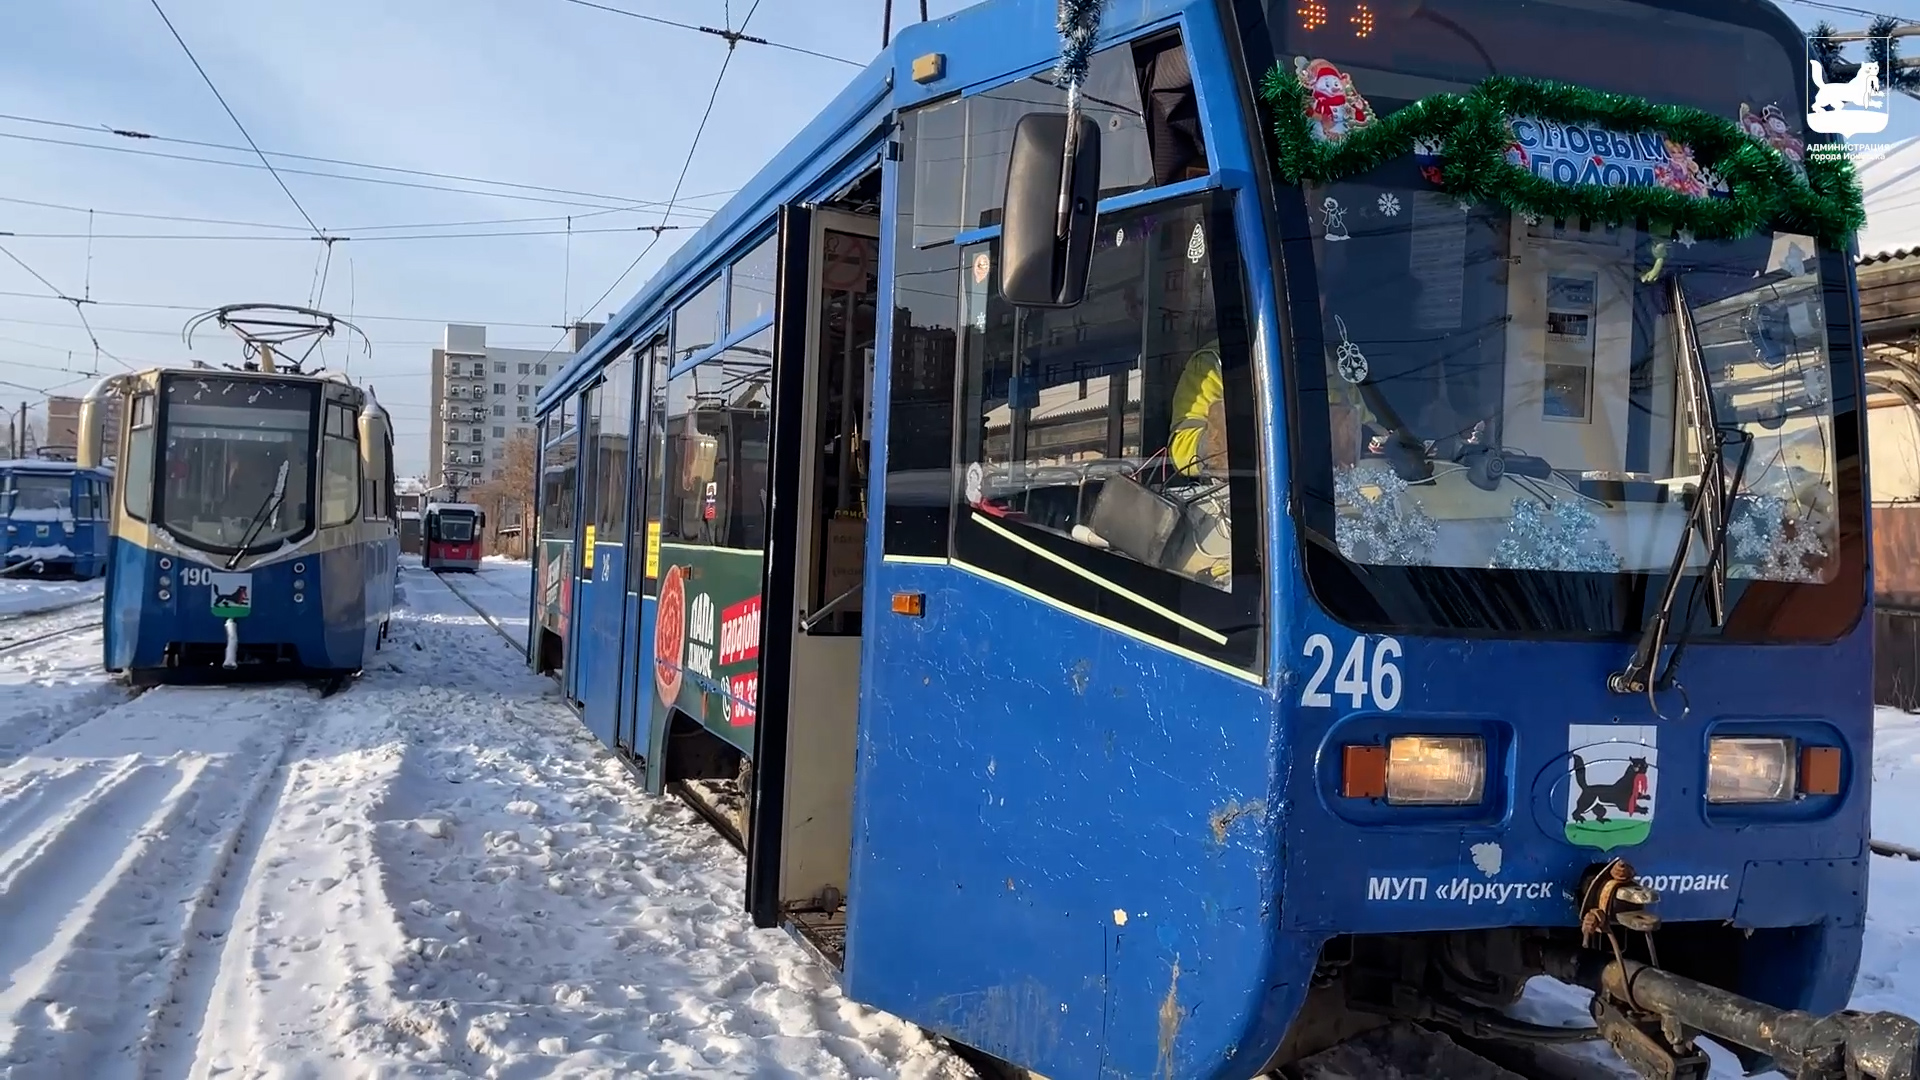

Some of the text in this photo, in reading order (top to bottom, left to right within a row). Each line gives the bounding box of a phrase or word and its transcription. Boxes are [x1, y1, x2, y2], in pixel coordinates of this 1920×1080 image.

[1511, 117, 1671, 162] С НОВЫМ
[180, 567, 212, 586] 190
[689, 592, 714, 646] ПАПА
[687, 642, 714, 679] ДЖОНС
[1301, 633, 1402, 711] 246
[1368, 877, 1427, 900] МУП
